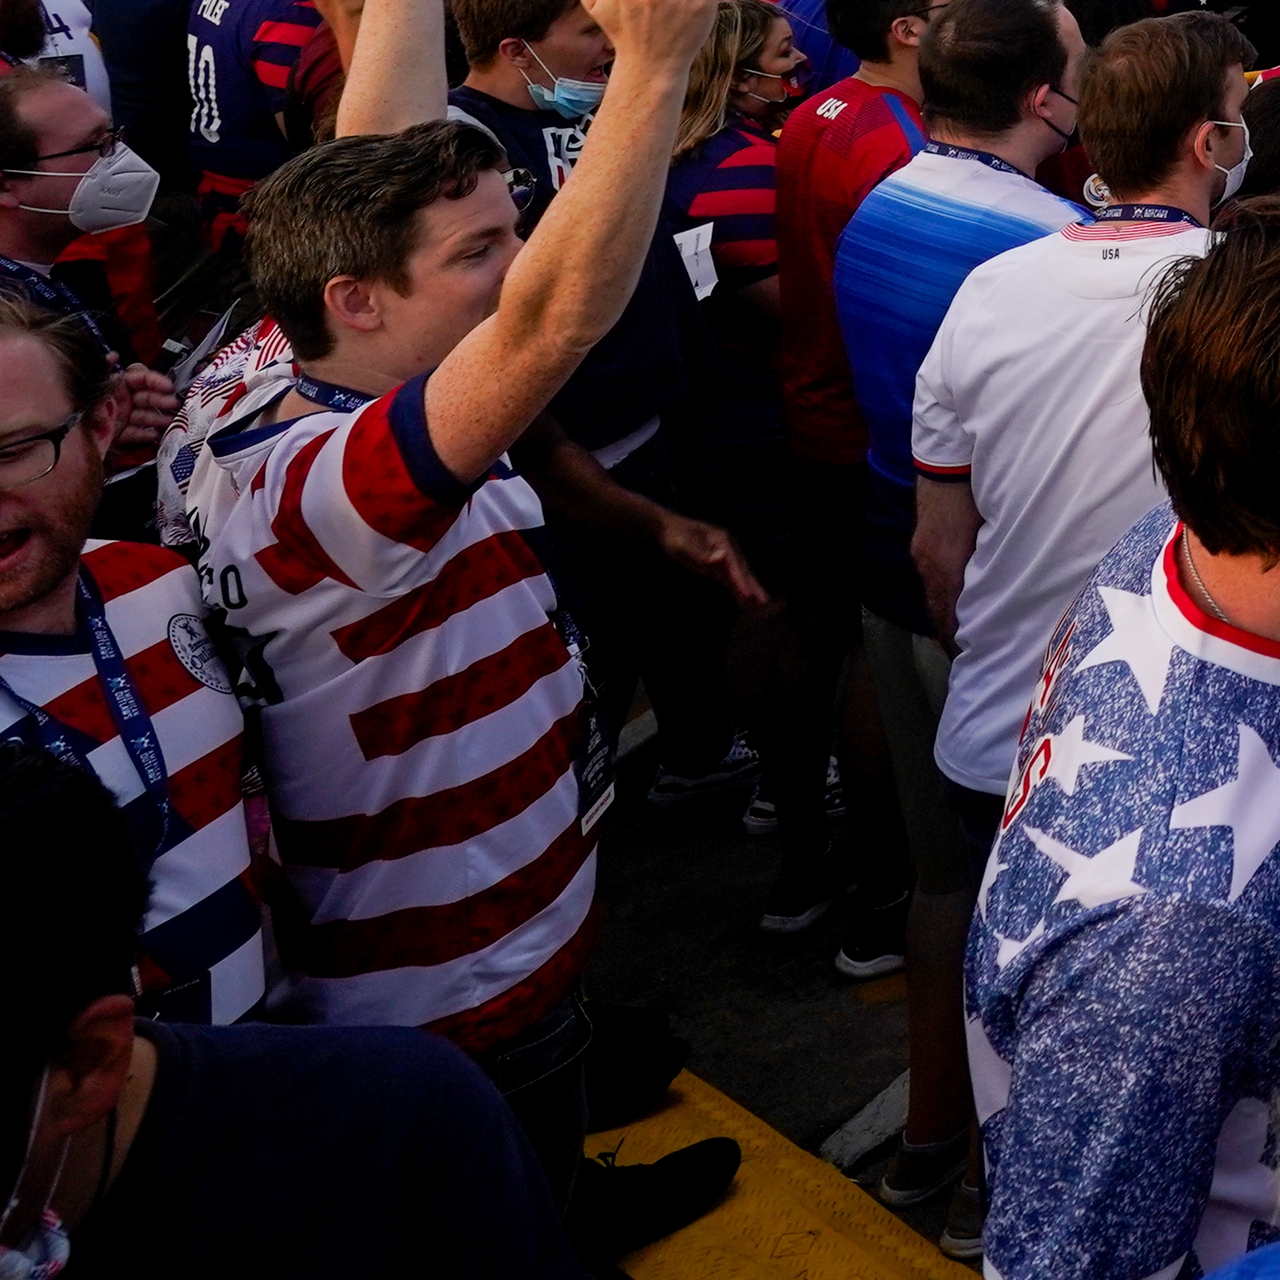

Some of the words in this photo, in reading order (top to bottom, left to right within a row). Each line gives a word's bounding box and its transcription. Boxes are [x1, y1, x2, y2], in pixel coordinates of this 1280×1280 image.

[815, 96, 849, 120] USA
[1102, 248, 1120, 260] USA
[114, 690, 134, 721] OUTLAWS
[123, 688, 140, 718] AMERICAN
[140, 751, 160, 785] OUTLAWS
[147, 748, 163, 781] AMERICAN
